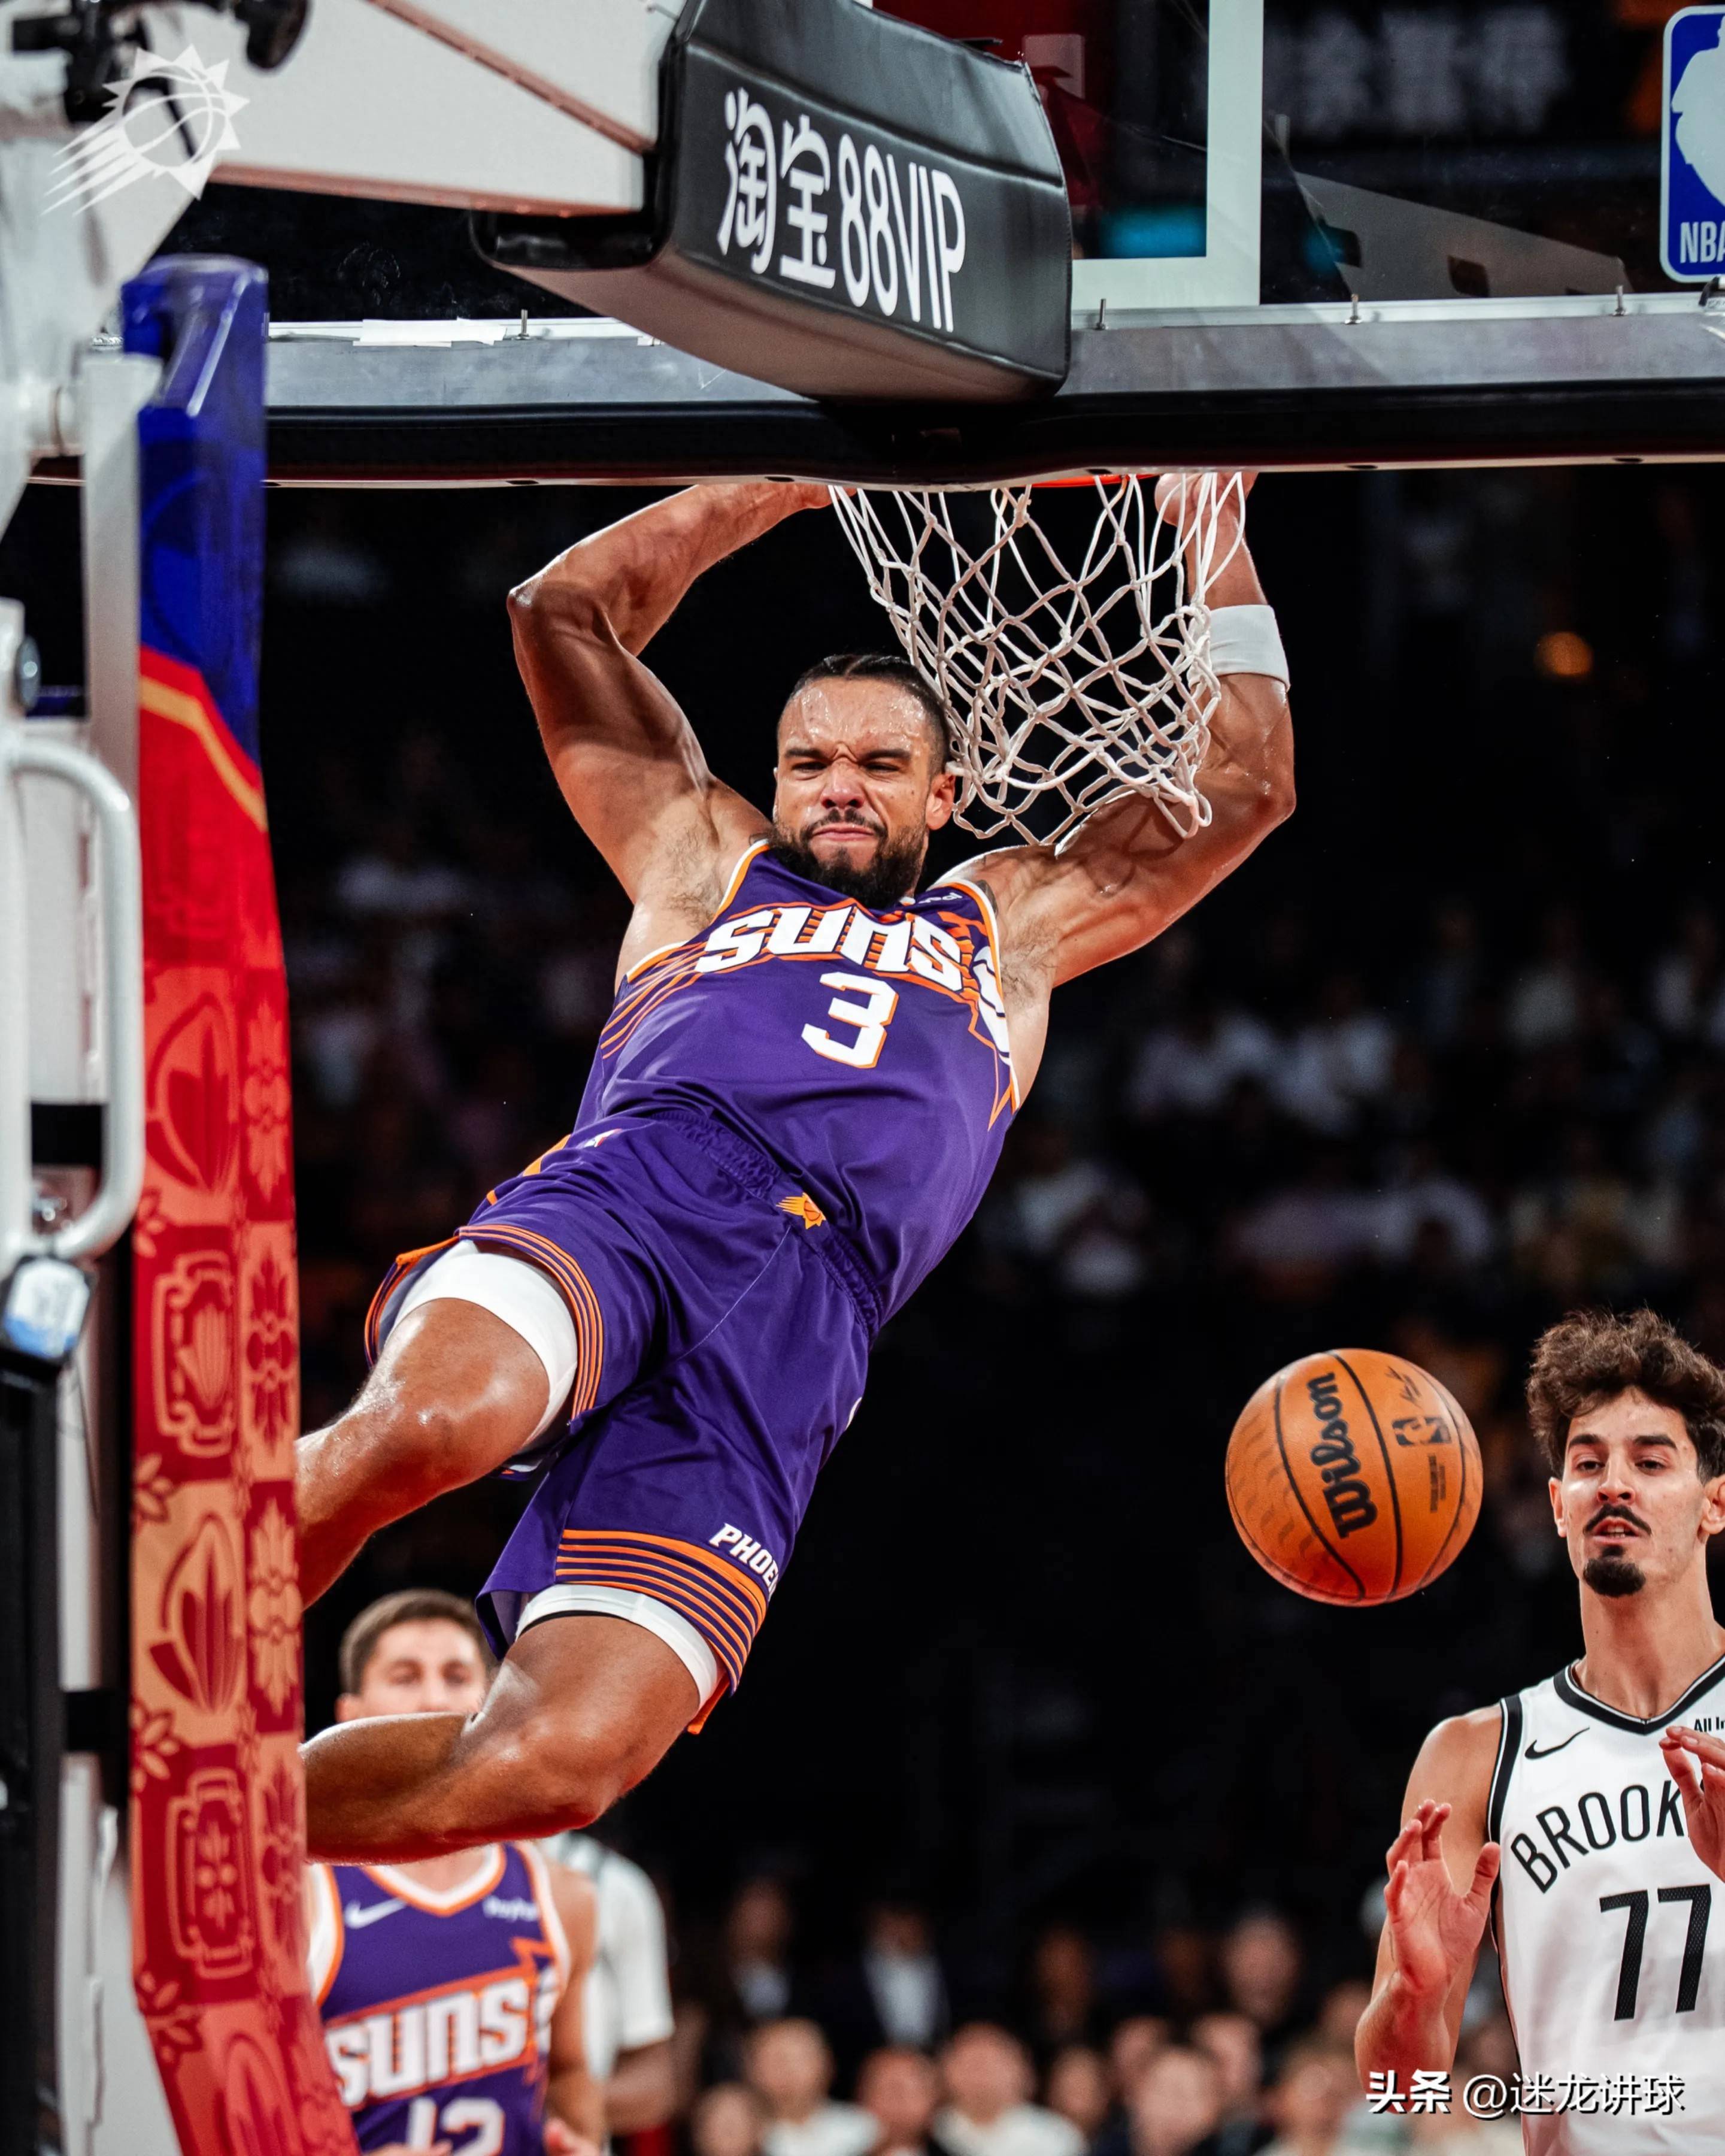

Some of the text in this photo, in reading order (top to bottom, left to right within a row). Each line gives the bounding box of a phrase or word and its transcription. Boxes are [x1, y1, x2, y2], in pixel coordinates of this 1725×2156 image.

[717, 87, 966, 332] 淘宝88VIP
[801, 972, 898, 1068] 3
[1306, 1372, 1377, 1539] Wilson
[708, 1522, 779, 1594] PHOE
[1694, 1718, 1712, 1733] All
[1511, 1779, 1685, 1893] BROOK
[1599, 1884, 1711, 2021] 77
